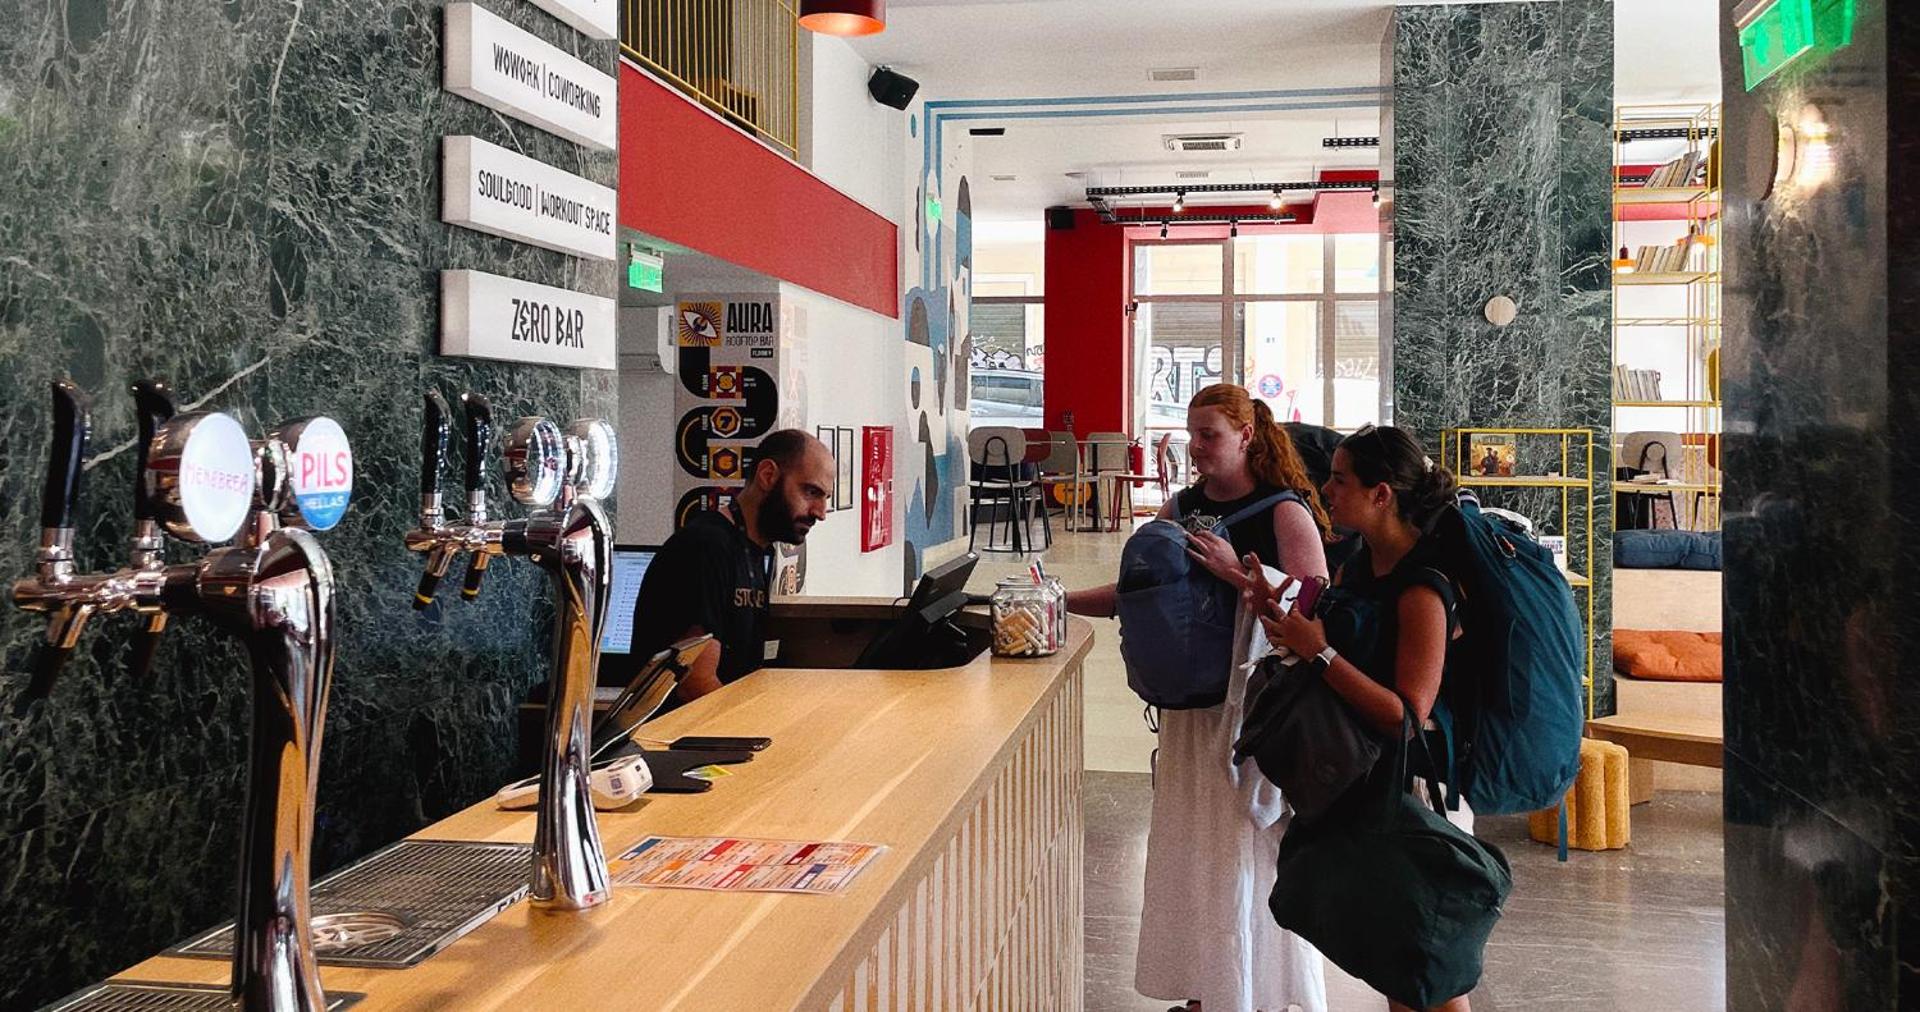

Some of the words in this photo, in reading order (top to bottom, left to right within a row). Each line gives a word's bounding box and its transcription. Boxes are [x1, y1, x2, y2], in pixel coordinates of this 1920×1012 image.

[493, 42, 540, 91] WOWORK
[548, 71, 601, 119] COWORKING
[478, 169, 532, 211] SOULGOOD
[541, 190, 584, 227] WORKOUT
[585, 205, 611, 235] SPACE
[511, 298, 550, 344] ZERO
[556, 306, 584, 349] BAR
[726, 302, 773, 333] AURA
[726, 335, 758, 346] ROOFTOP
[759, 335, 774, 347] BAR
[720, 415, 733, 429] 7
[302, 451, 348, 489] PILS
